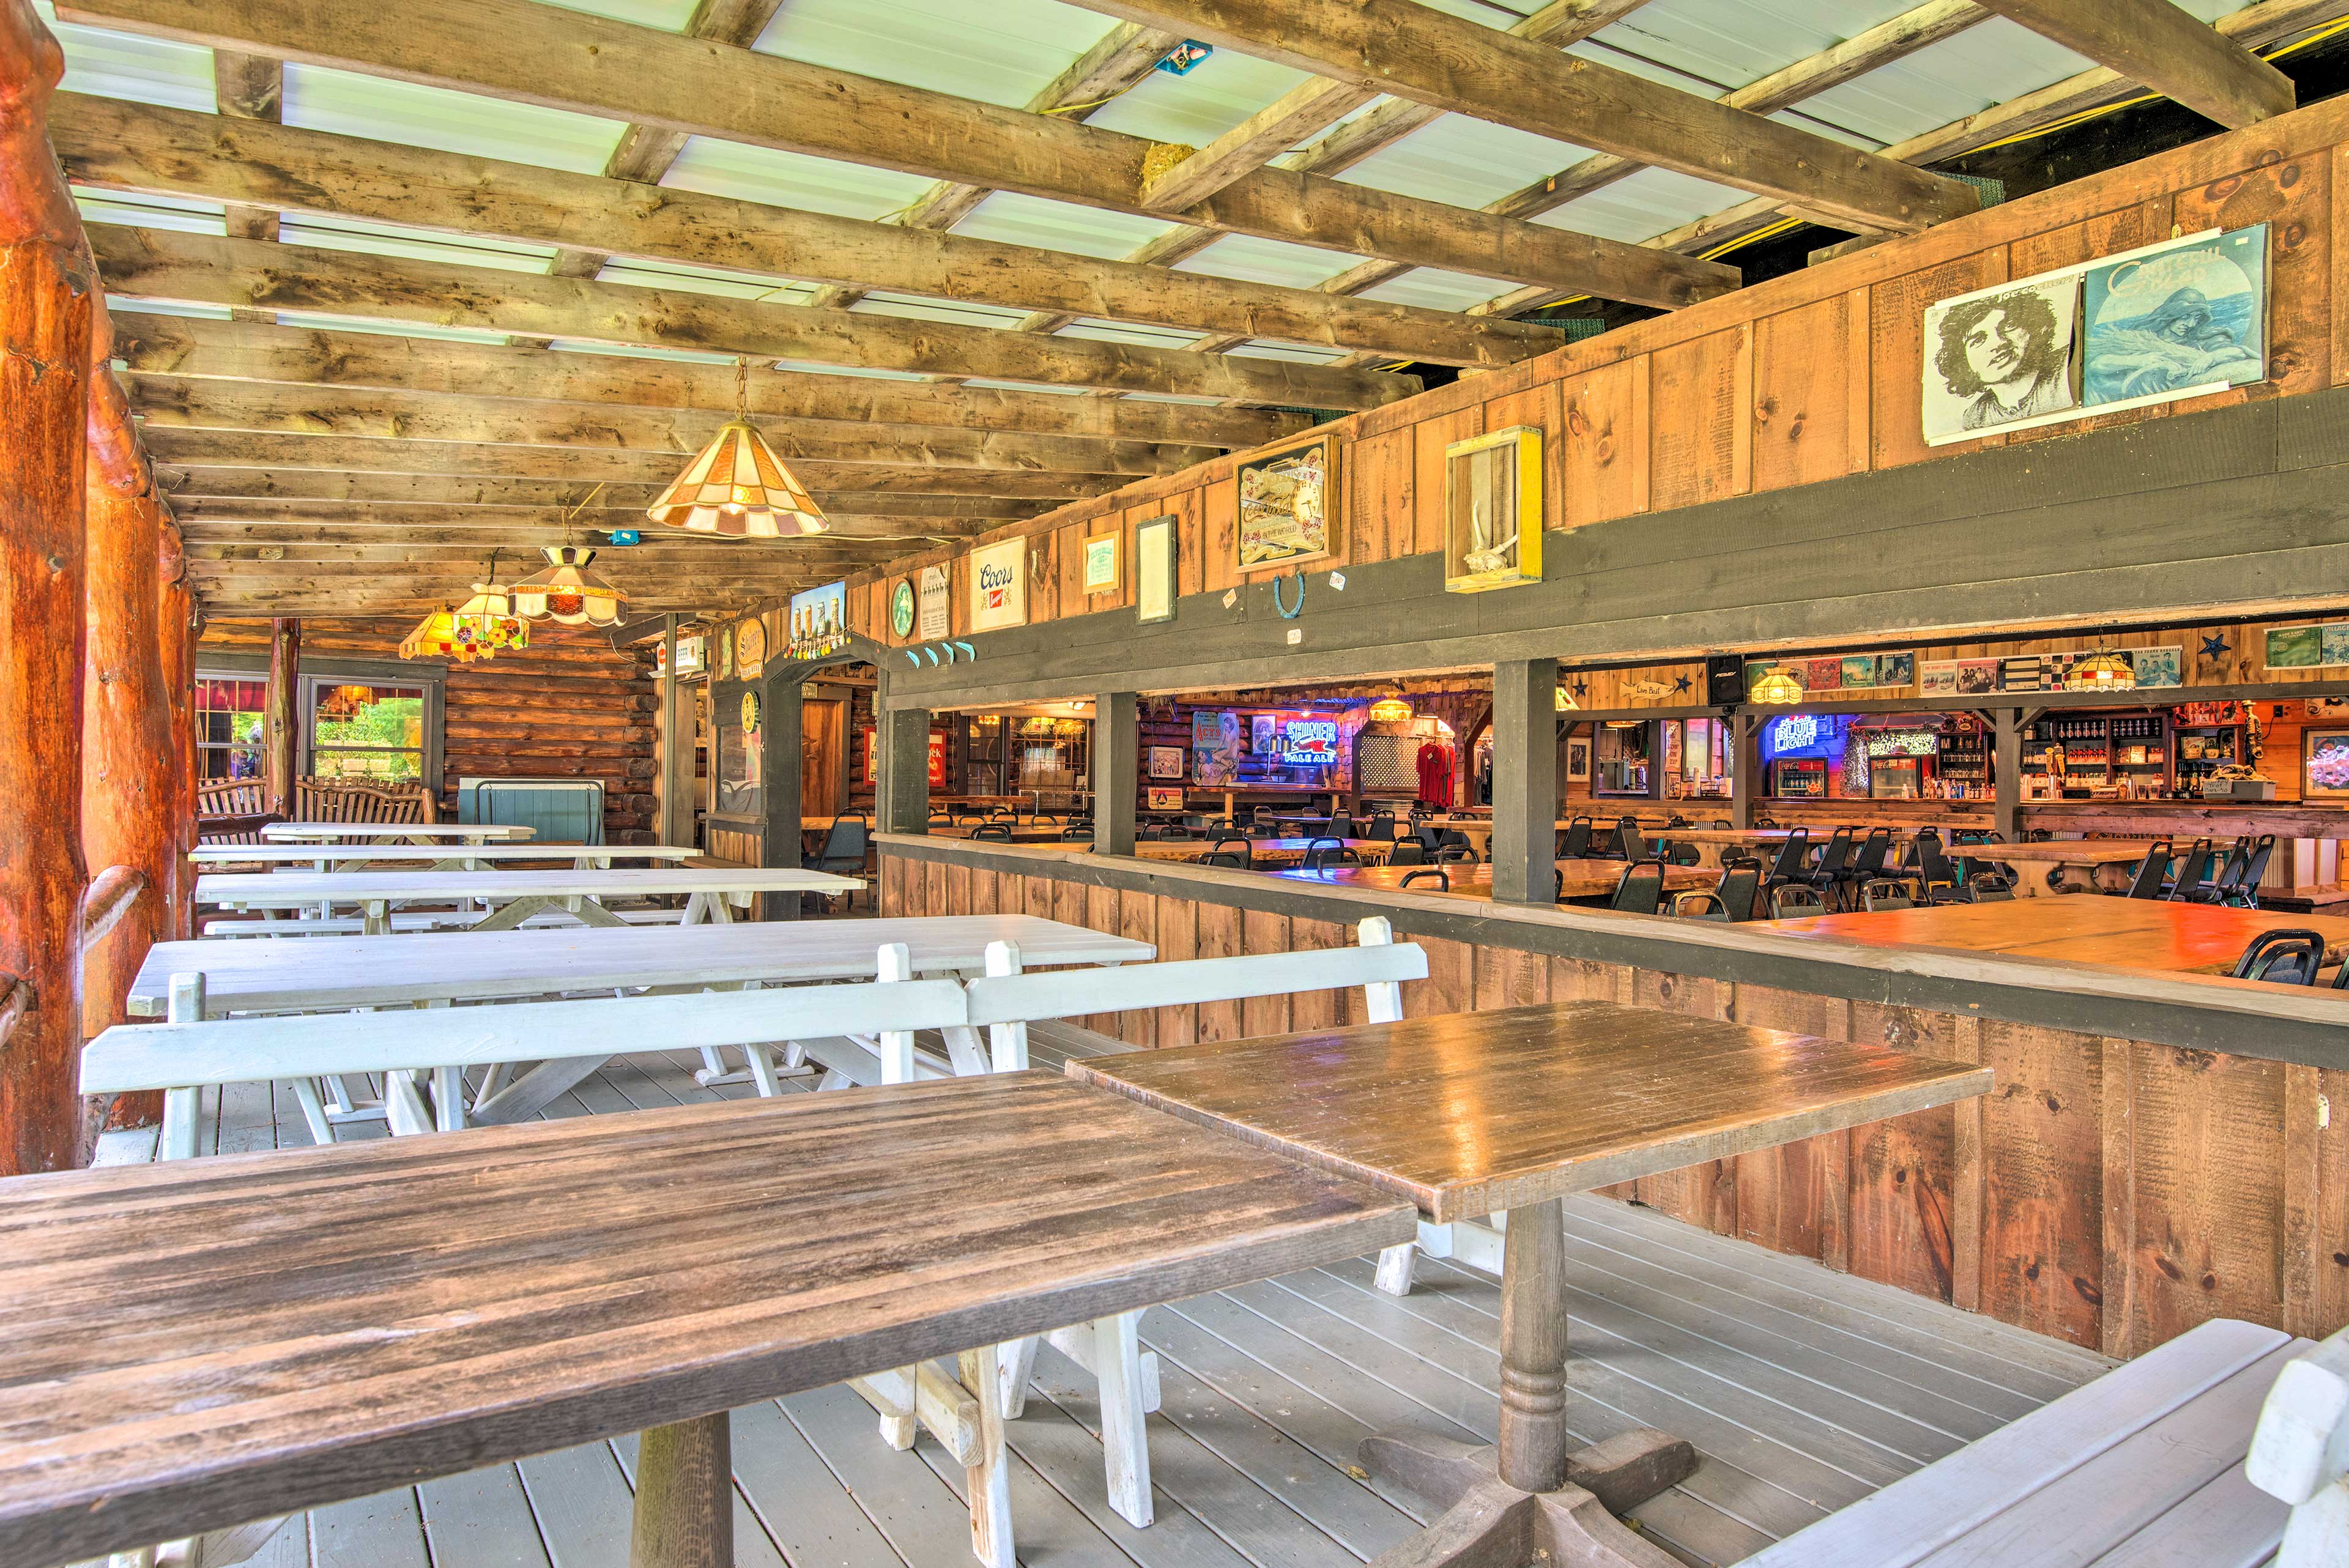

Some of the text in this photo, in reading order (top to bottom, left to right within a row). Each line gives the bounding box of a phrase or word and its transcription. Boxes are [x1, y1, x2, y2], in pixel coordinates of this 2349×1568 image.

[1276, 525, 1297, 536] WORLD
[980, 564, 1013, 590] Coors
[1195, 721, 1221, 741] ACTS
[1286, 721, 1335, 742] SHINER
[1775, 719, 1817, 740] BLUE
[1775, 734, 1814, 752] LIGHT
[1285, 754, 1335, 763] PALE ALE
